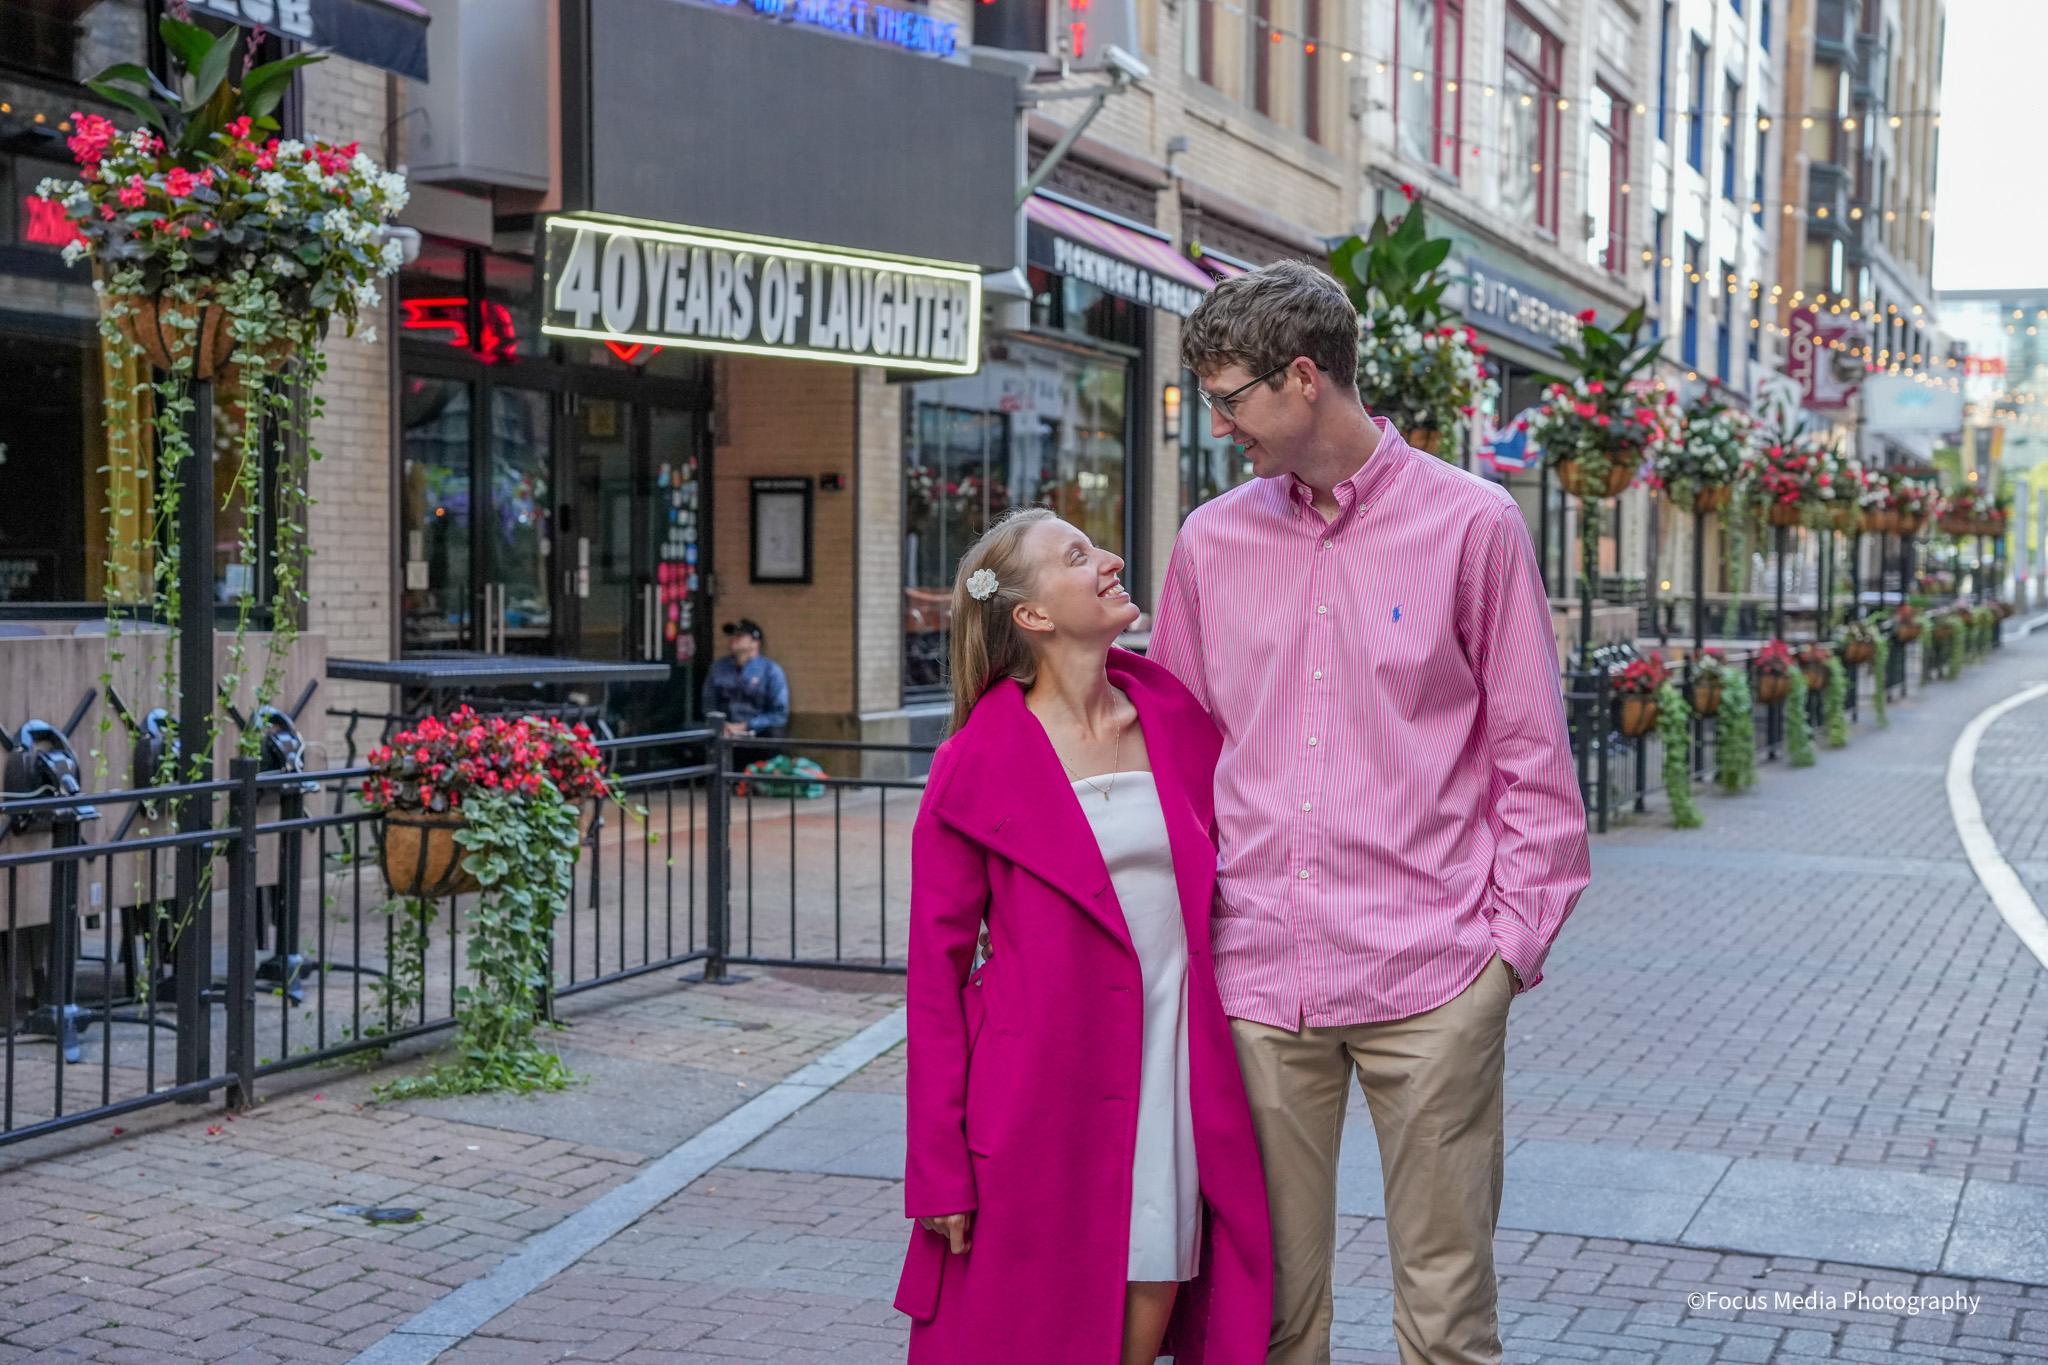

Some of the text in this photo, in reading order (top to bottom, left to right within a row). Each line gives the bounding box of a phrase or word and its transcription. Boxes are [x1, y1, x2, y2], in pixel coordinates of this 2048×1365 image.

[556, 228, 970, 362] 40 YEARS OF LAUGHTER
[1053, 236, 1138, 299] PICKWICK
[1138, 269, 1151, 304] &
